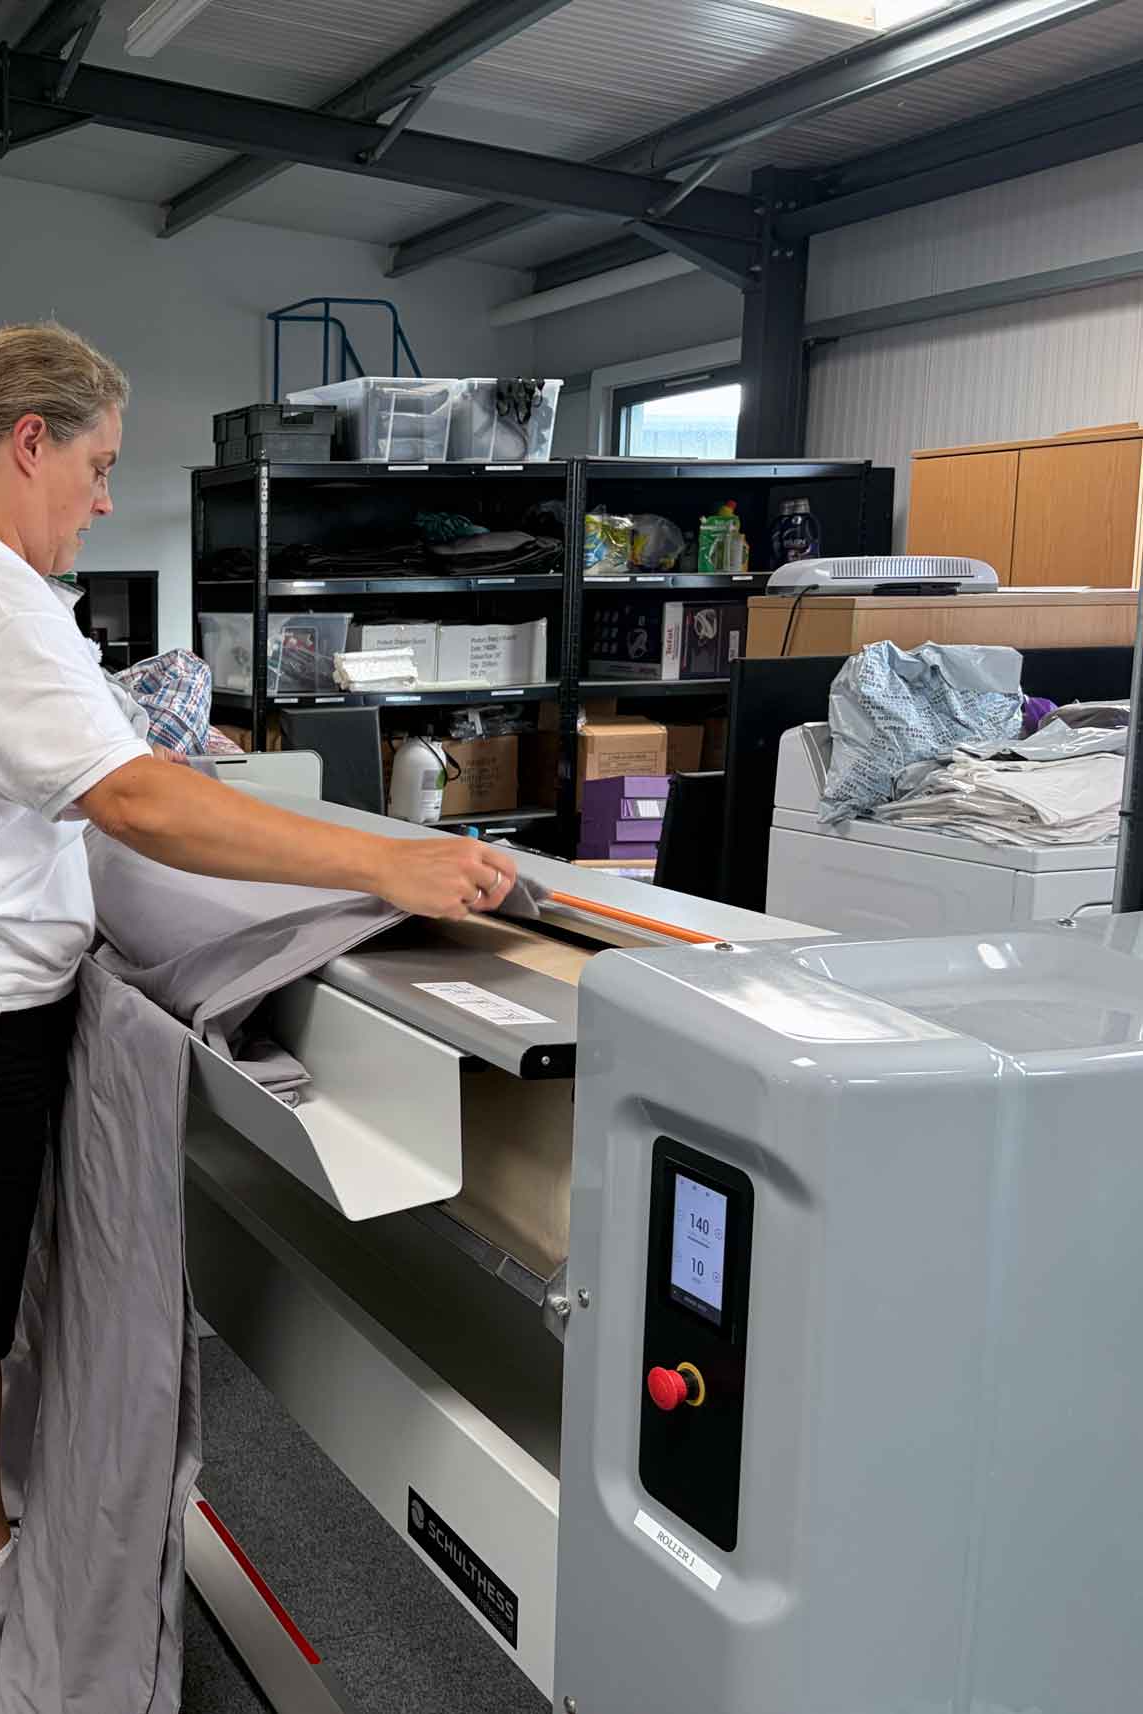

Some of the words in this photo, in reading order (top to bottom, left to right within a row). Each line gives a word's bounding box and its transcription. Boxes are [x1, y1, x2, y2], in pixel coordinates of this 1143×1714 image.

[689, 1212, 710, 1235] 140
[690, 1256, 705, 1277] 10
[657, 1530, 690, 1563] ROLLER
[427, 1519, 515, 1623] SCHULTHESS
